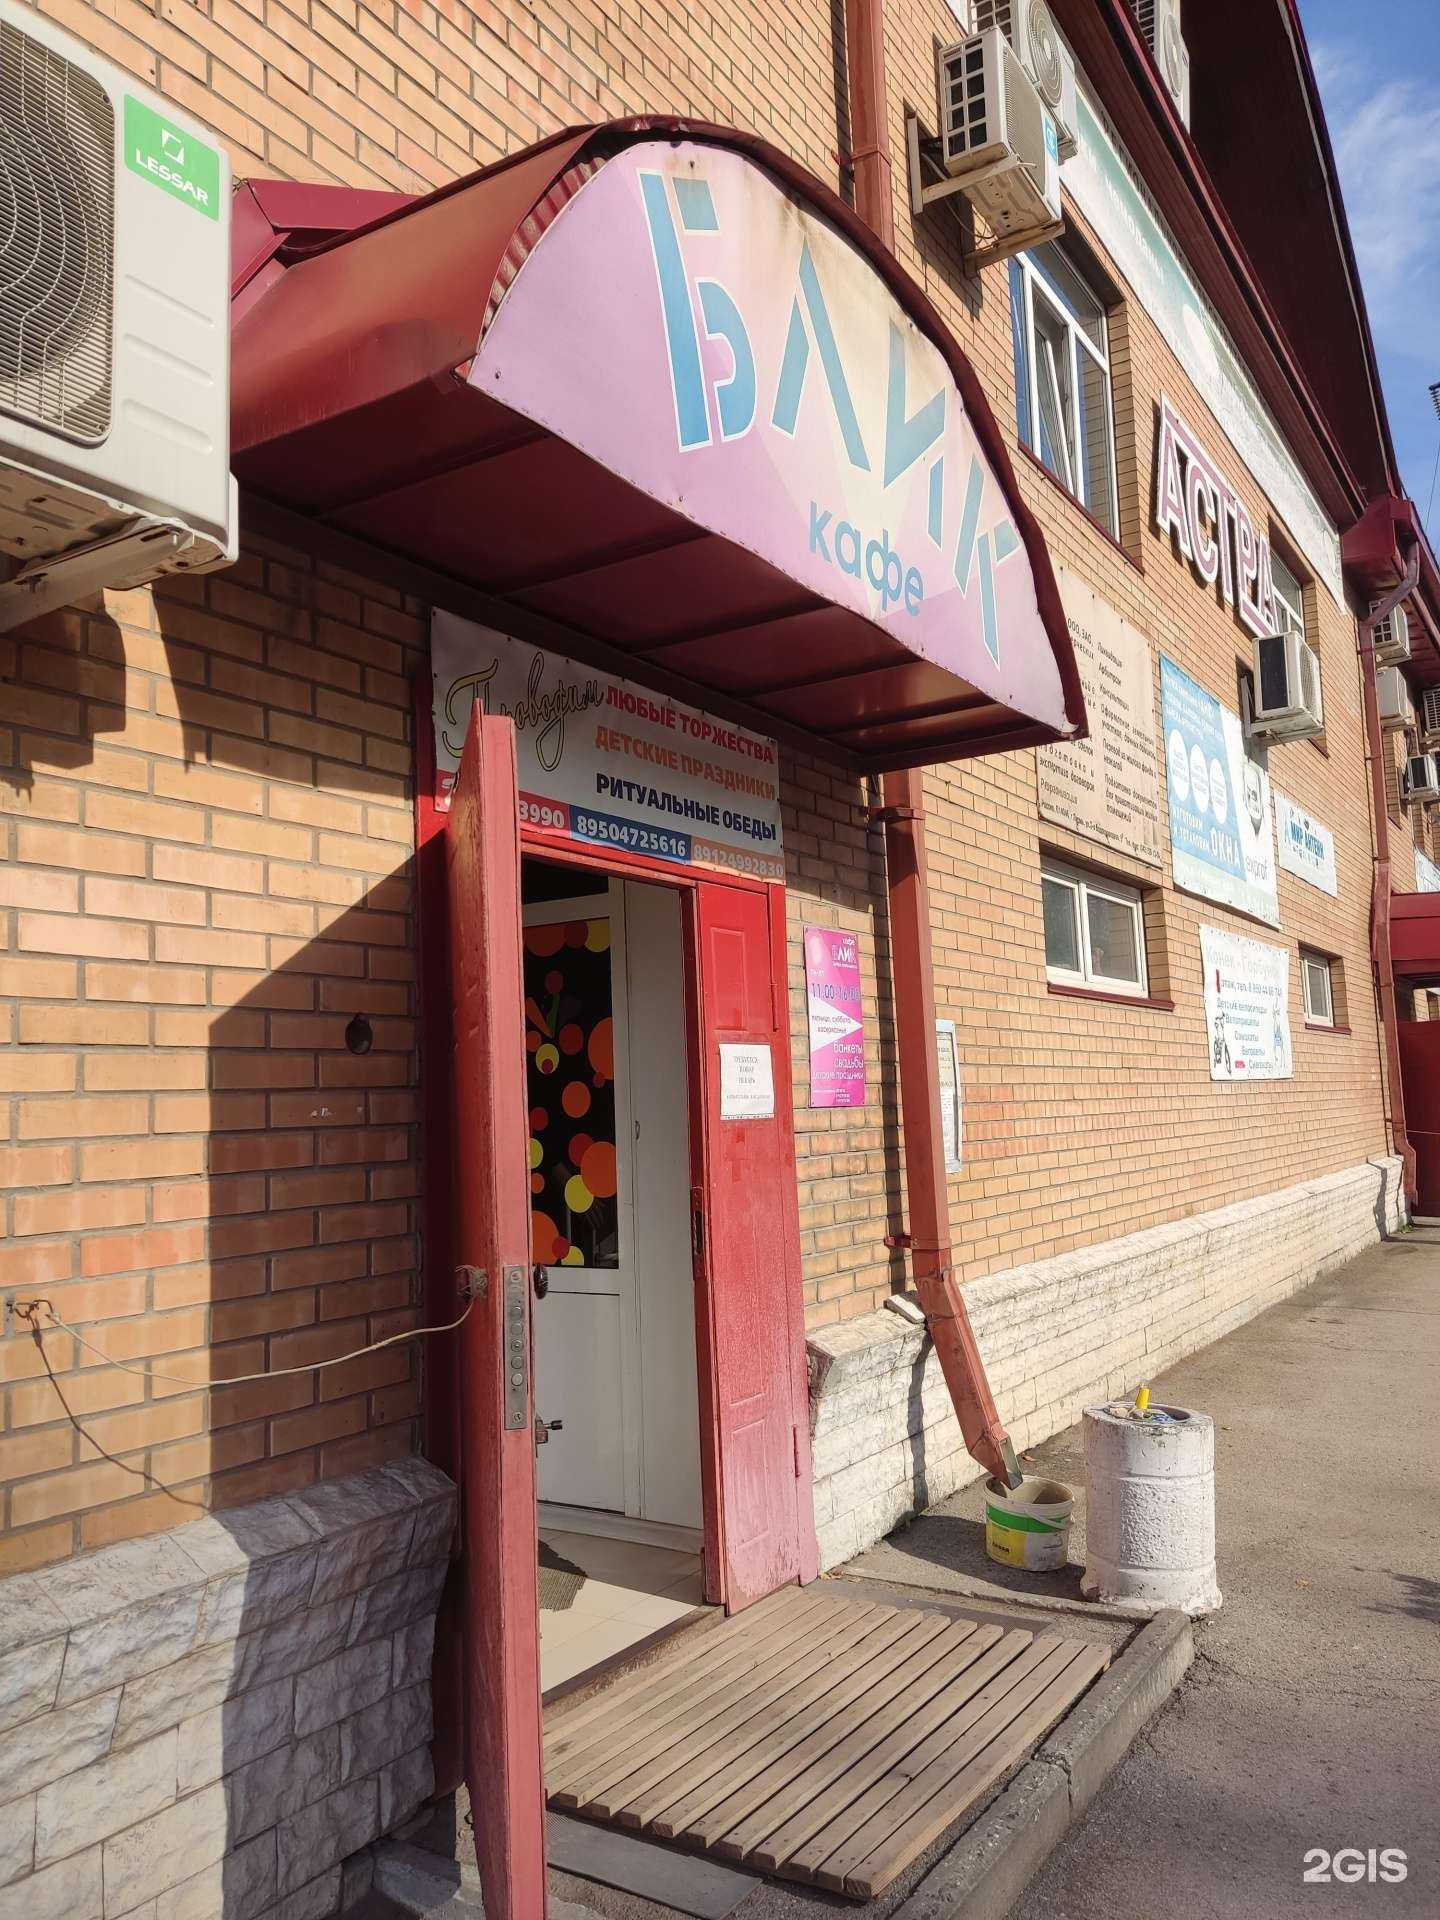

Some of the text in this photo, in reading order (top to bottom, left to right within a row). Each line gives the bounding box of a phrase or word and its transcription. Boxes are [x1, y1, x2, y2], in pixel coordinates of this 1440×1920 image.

[136, 148, 209, 206] LESSAR
[635, 167, 1023, 672] БЛИК
[1156, 392, 1280, 637] АСТРА
[808, 500, 925, 616] кафе
[595, 725, 776, 800] ДЕТСКИЕ ПРАЗДНИКИ
[606, 685, 775, 764] ЛЮБЫЕ ТОРЖЕСТВА
[576, 815, 686, 857] 89504725616
[596, 773, 777, 841] РИТУАЛЬНЫЕ ОБЕДЫ
